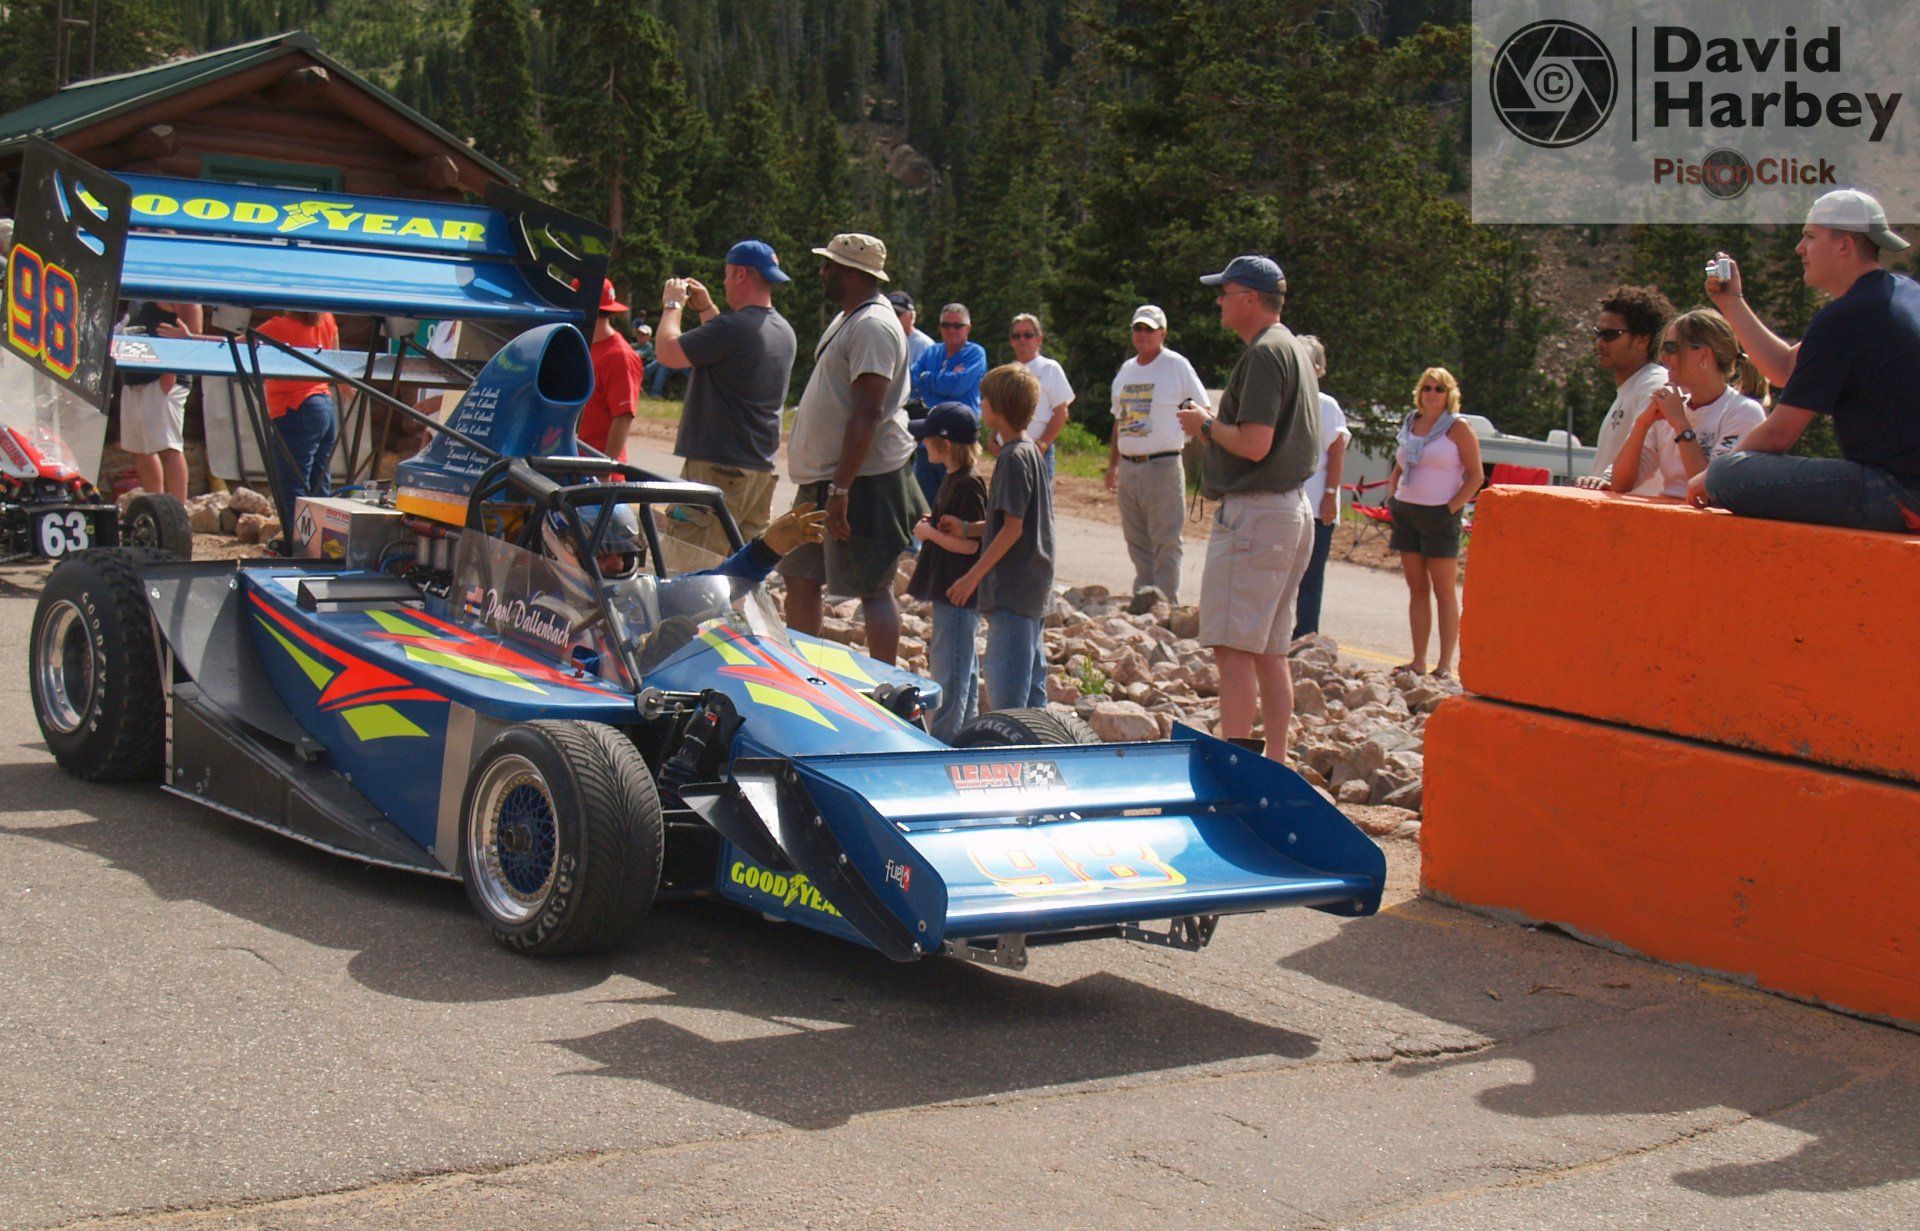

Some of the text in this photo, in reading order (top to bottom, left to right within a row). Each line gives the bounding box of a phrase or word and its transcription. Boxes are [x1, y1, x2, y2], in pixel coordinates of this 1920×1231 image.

[8, 243, 79, 380] 98
[41, 511, 89, 557] 63
[485, 588, 571, 648] Paul Dallenbach
[975, 720, 1024, 743] EAGLE
[951, 762, 1023, 790] LEARY
